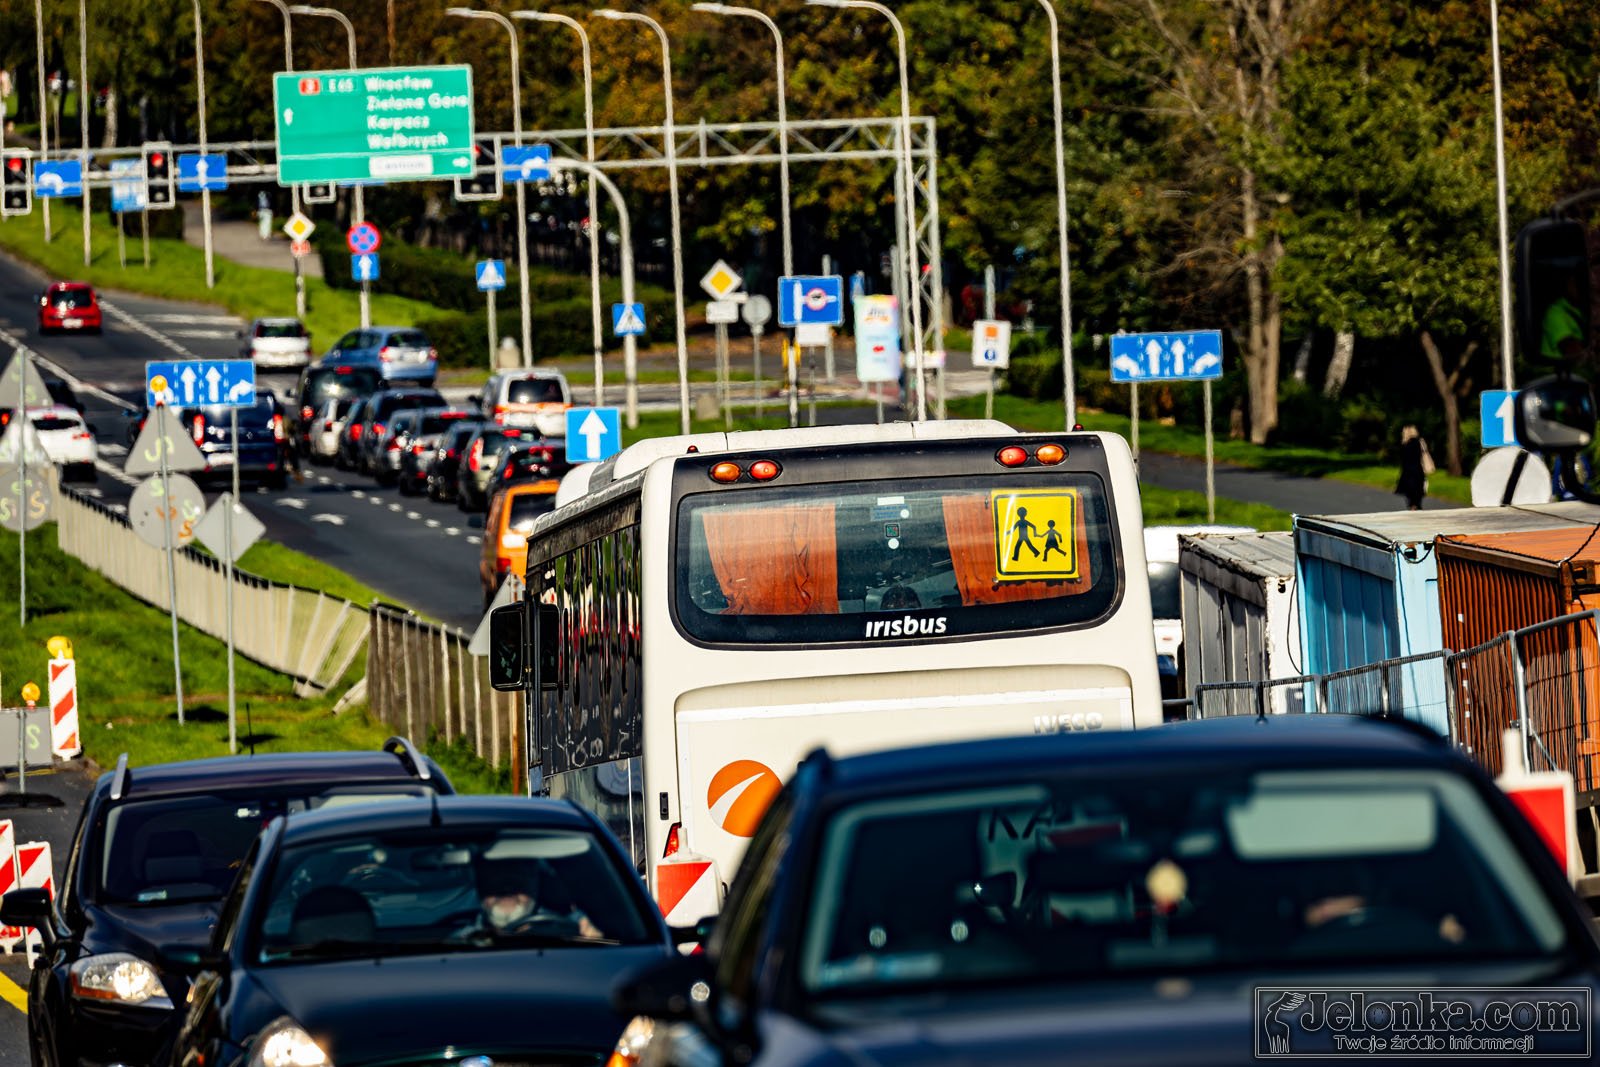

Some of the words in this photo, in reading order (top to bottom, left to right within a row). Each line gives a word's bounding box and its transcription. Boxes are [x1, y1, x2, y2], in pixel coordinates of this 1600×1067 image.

[367, 95, 425, 111] Zielona
[367, 115, 430, 131] Karpacz
[1033, 711, 1103, 734] IVECO
